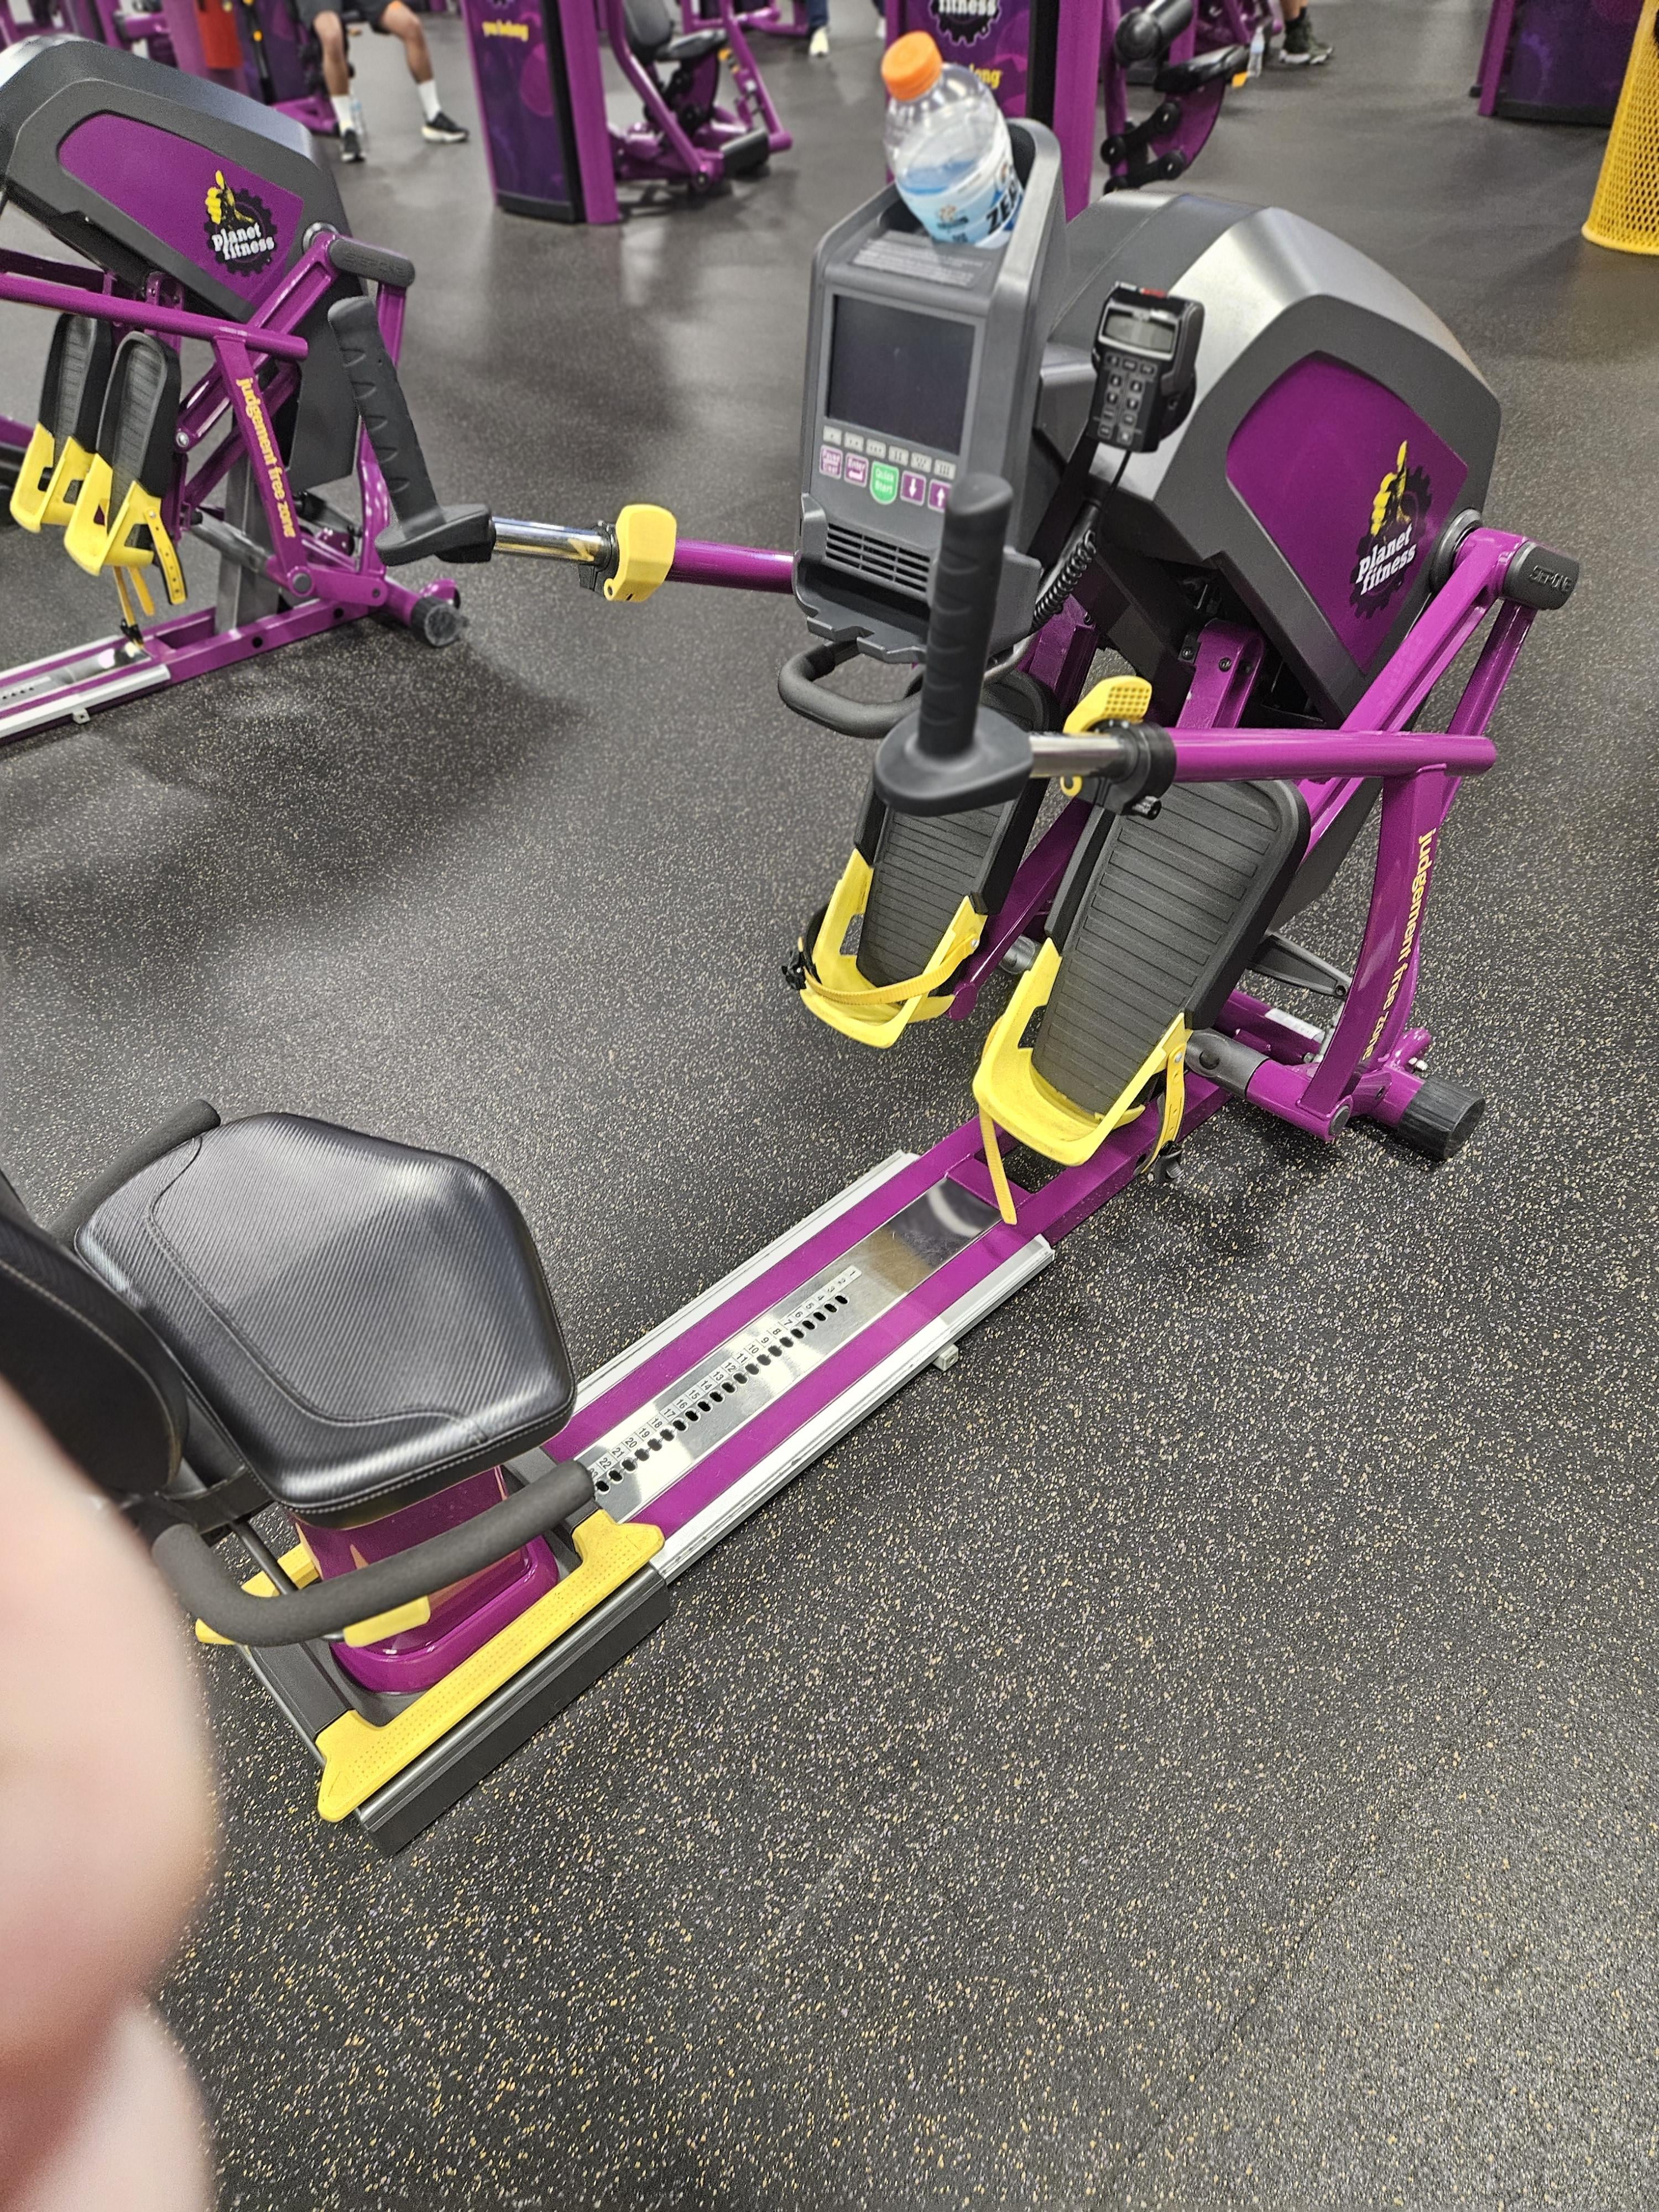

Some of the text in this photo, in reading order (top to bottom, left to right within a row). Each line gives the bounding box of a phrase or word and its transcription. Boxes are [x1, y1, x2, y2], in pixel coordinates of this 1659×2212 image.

[222, 237, 275, 260] fitness
[236, 377, 296, 538] judgement free zone
[1355, 523, 1413, 585] planet
[1360, 544, 1417, 596] fitness
[1361, 827, 1437, 1061] judgement free zone
[748, 1344, 759, 1354] 10
[737, 1353, 748, 1363] 11
[724, 1361, 737, 1373] 12
[713, 1371, 724, 1381] 13
[701, 1380, 713, 1391] 14
[688, 1389, 701, 1400] 15
[676, 1399, 688, 1409] 16
[664, 1408, 676, 1418] 17
[651, 1417, 662, 1428] 18
[638, 1428, 650, 1438] 19
[625, 1437, 638, 1448] 20
[612, 1447, 625, 1458] 21
[599, 1457, 612, 1469] 22
